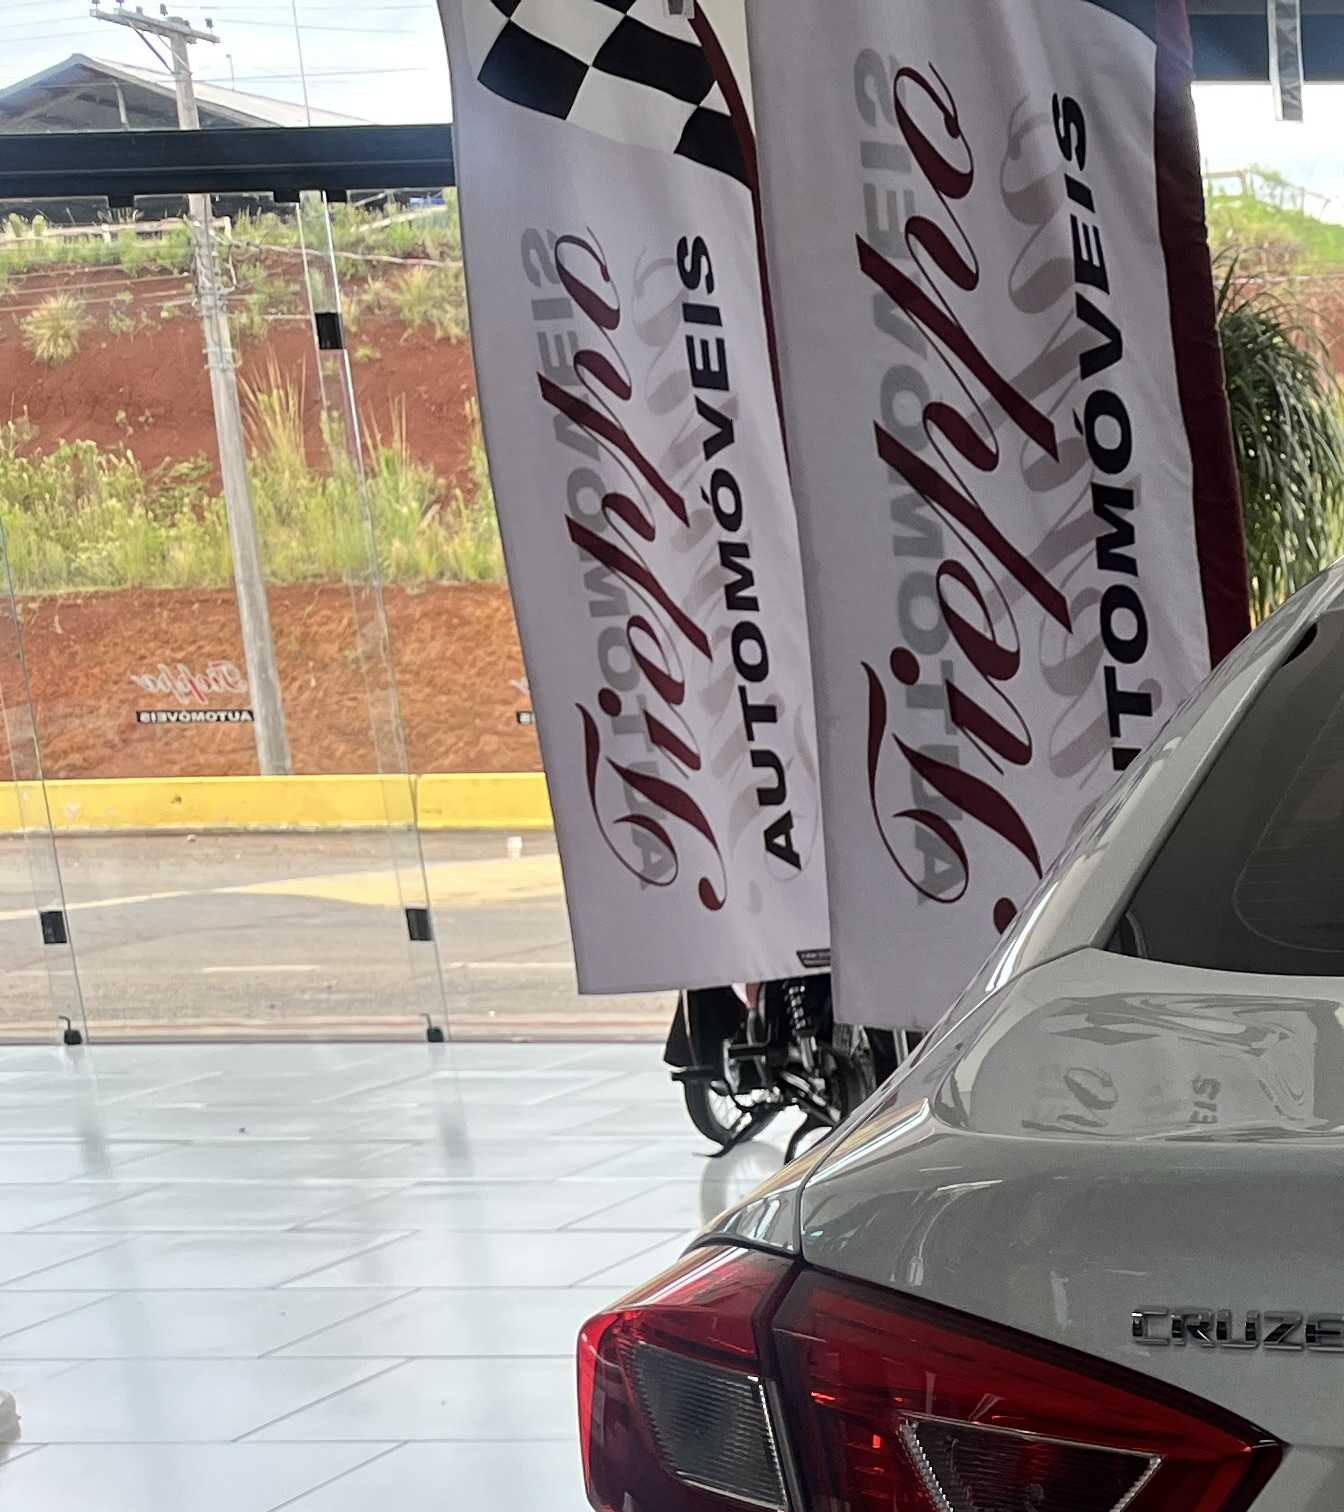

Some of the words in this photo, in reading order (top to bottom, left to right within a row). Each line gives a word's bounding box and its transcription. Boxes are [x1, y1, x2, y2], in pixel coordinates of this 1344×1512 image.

[536, 225, 728, 912] Tieppo
[676, 235, 803, 870] AUTOMÓVEIS
[856, 61, 1074, 935] Tieppo
[1053, 92, 1149, 771] TOMÓVEIS
